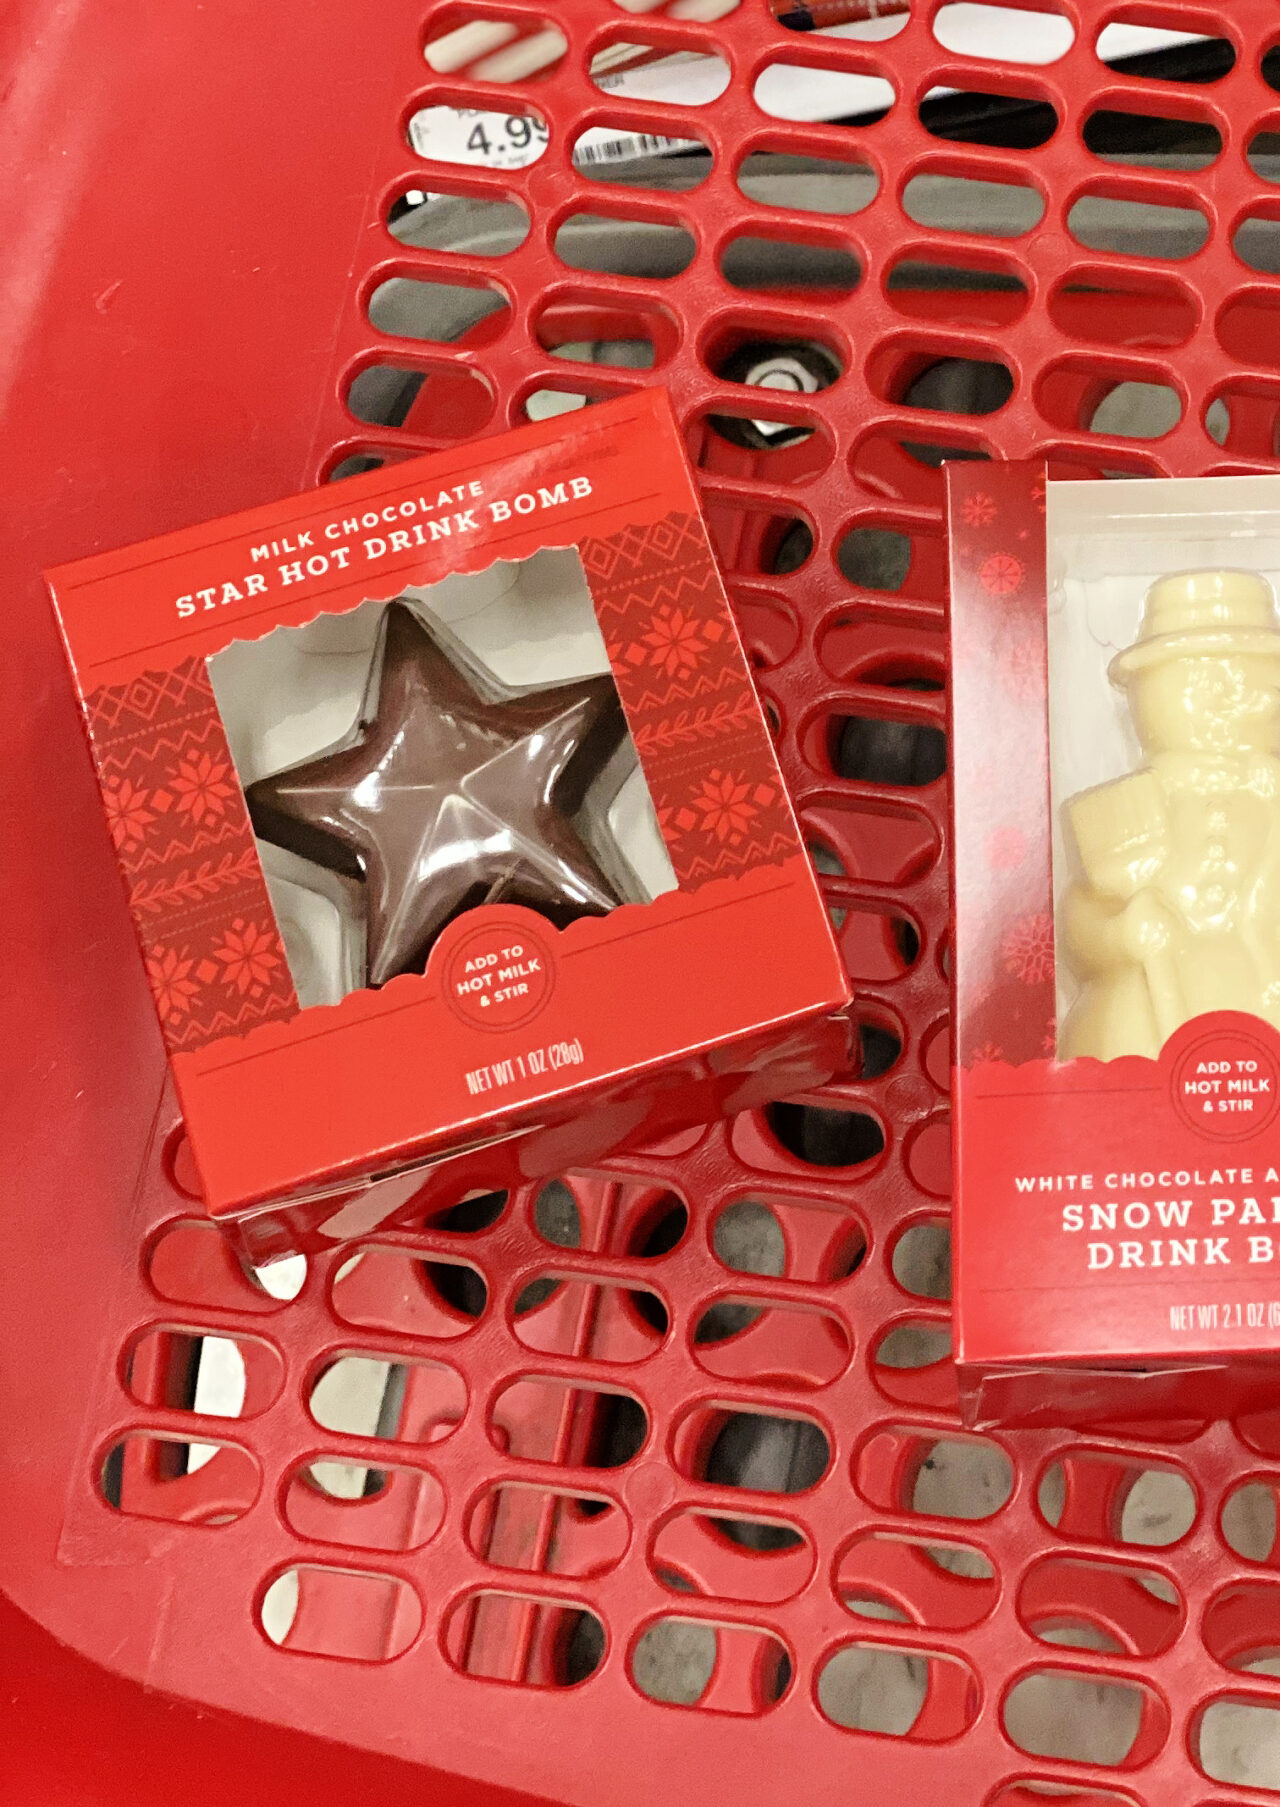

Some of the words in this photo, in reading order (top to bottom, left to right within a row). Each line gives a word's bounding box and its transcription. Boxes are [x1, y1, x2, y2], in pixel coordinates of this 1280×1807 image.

[250, 531, 315, 562] MILK
[324, 480, 485, 540] CHOCOLATE
[174, 574, 269, 618] STAR
[277, 547, 353, 586] HOT
[364, 511, 481, 560] DRINK
[489, 476, 594, 523] BOMB
[465, 953, 498, 973] ADD
[501, 945, 524, 960] TO
[457, 973, 493, 995] HOT
[498, 958, 541, 983] MILK
[480, 995, 490, 1007] &
[494, 983, 528, 1003] STIR
[465, 1067, 493, 1095] NET
[492, 1059, 515, 1086] WT
[516, 1056, 526, 1078] 1
[528, 1049, 548, 1075] OZ
[548, 1038, 584, 1071] (28g)
[1196, 1061, 1232, 1075] ADD
[1235, 1059, 1258, 1074] TO
[1184, 1079, 1225, 1095] HOT
[1228, 1078, 1271, 1093] MILK
[1203, 1100, 1214, 1113] &
[1218, 1099, 1254, 1113] STIR
[1015, 1174, 1094, 1193] WHITE
[1105, 1168, 1254, 1190] CHOCOLATE
[1062, 1199, 1193, 1232] SNOW
[1087, 1237, 1231, 1269] DRINK
[1170, 1305, 1195, 1331] NET
[1197, 1304, 1219, 1329] WT
[1223, 1303, 1242, 1328] 2.1
[1247, 1302, 1267, 1327] OZ
